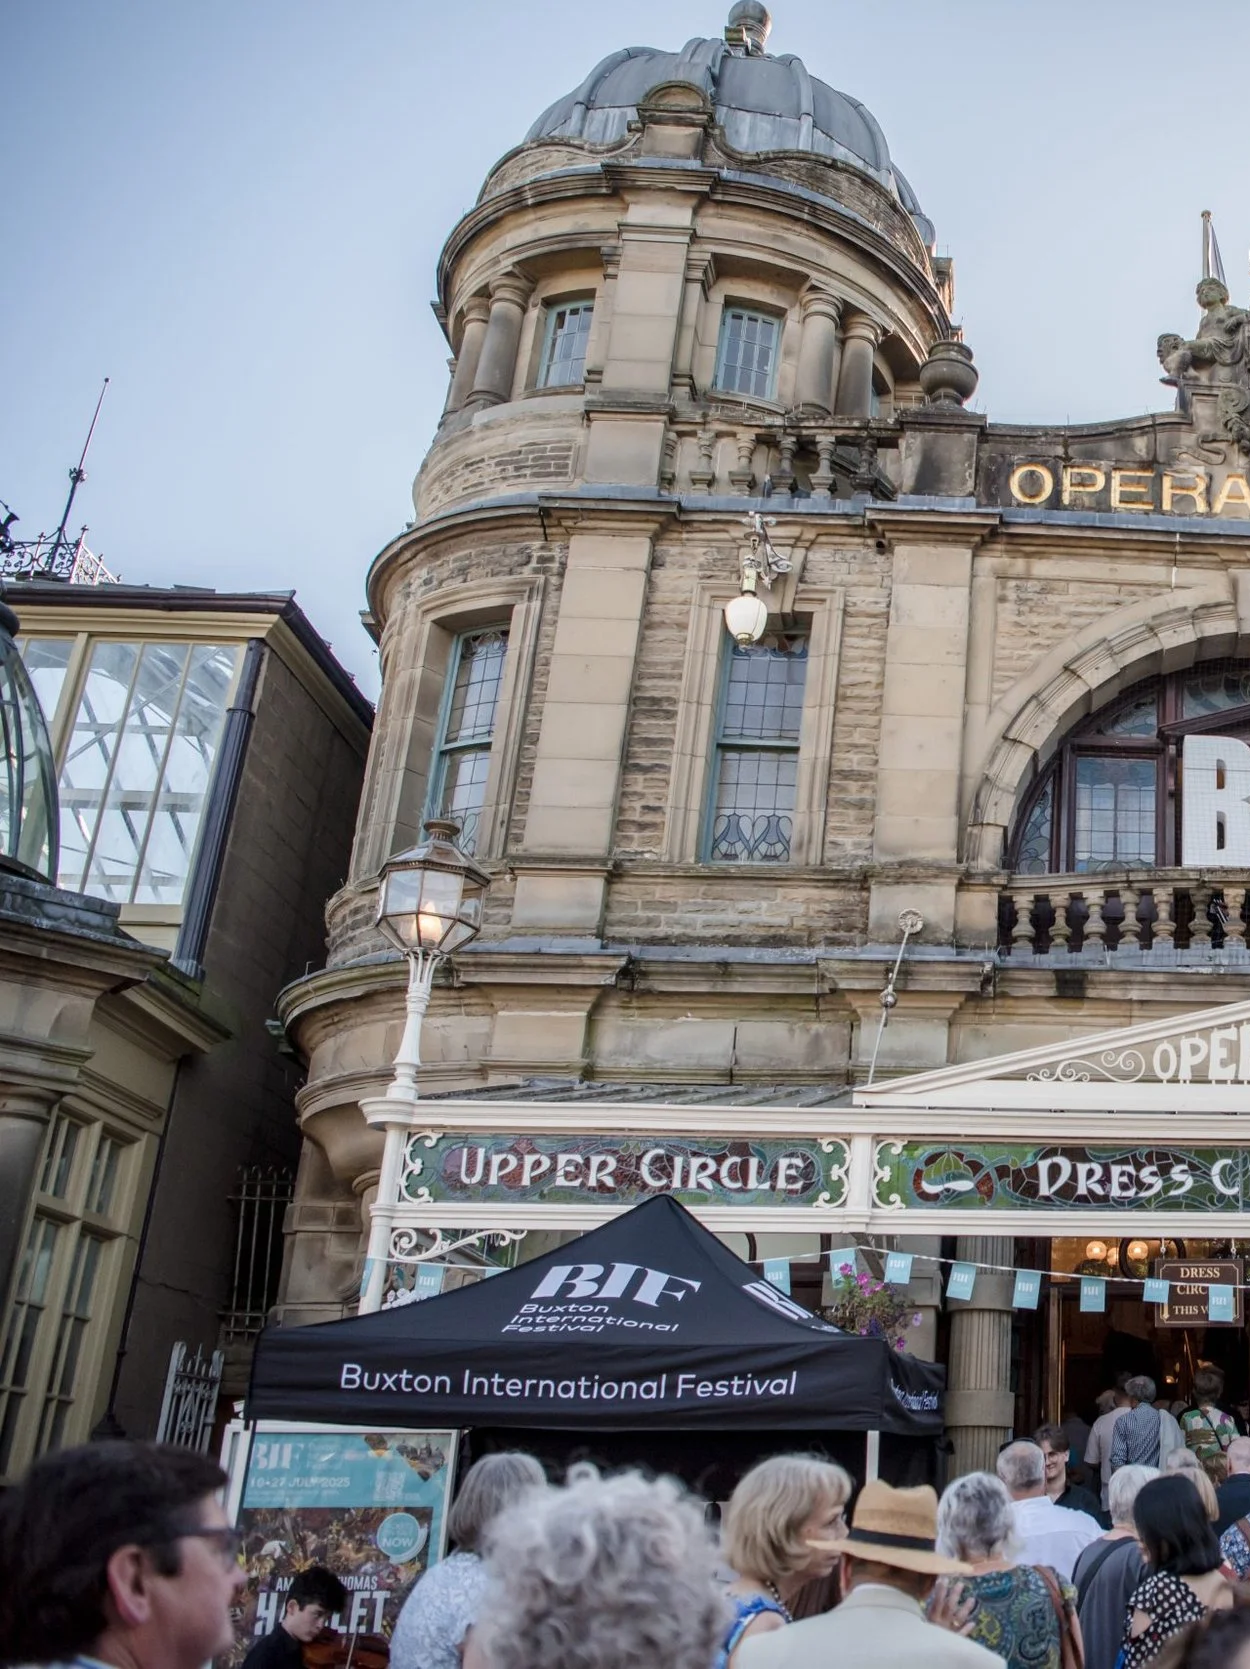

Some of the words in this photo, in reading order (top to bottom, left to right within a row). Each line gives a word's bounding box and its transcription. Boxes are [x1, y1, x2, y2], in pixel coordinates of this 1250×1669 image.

[459, 1147, 618, 1188] UPPER
[639, 1148, 805, 1190] CIRCLE
[1037, 1156, 1195, 1197] DRESS
[1180, 1267, 1220, 1278] DRESS
[530, 1262, 702, 1307] BIF
[1176, 1284, 1207, 1295] CIRC
[519, 1303, 610, 1314] Buxton
[1173, 1305, 1199, 1315] THIS
[510, 1314, 679, 1332] International
[501, 1324, 605, 1334] Festival
[340, 1363, 452, 1395] Buxton
[462, 1368, 667, 1400] International
[677, 1370, 798, 1398] Festival
[321, 1477, 351, 1488] 2025
[382, 1537, 413, 1547] NOW
